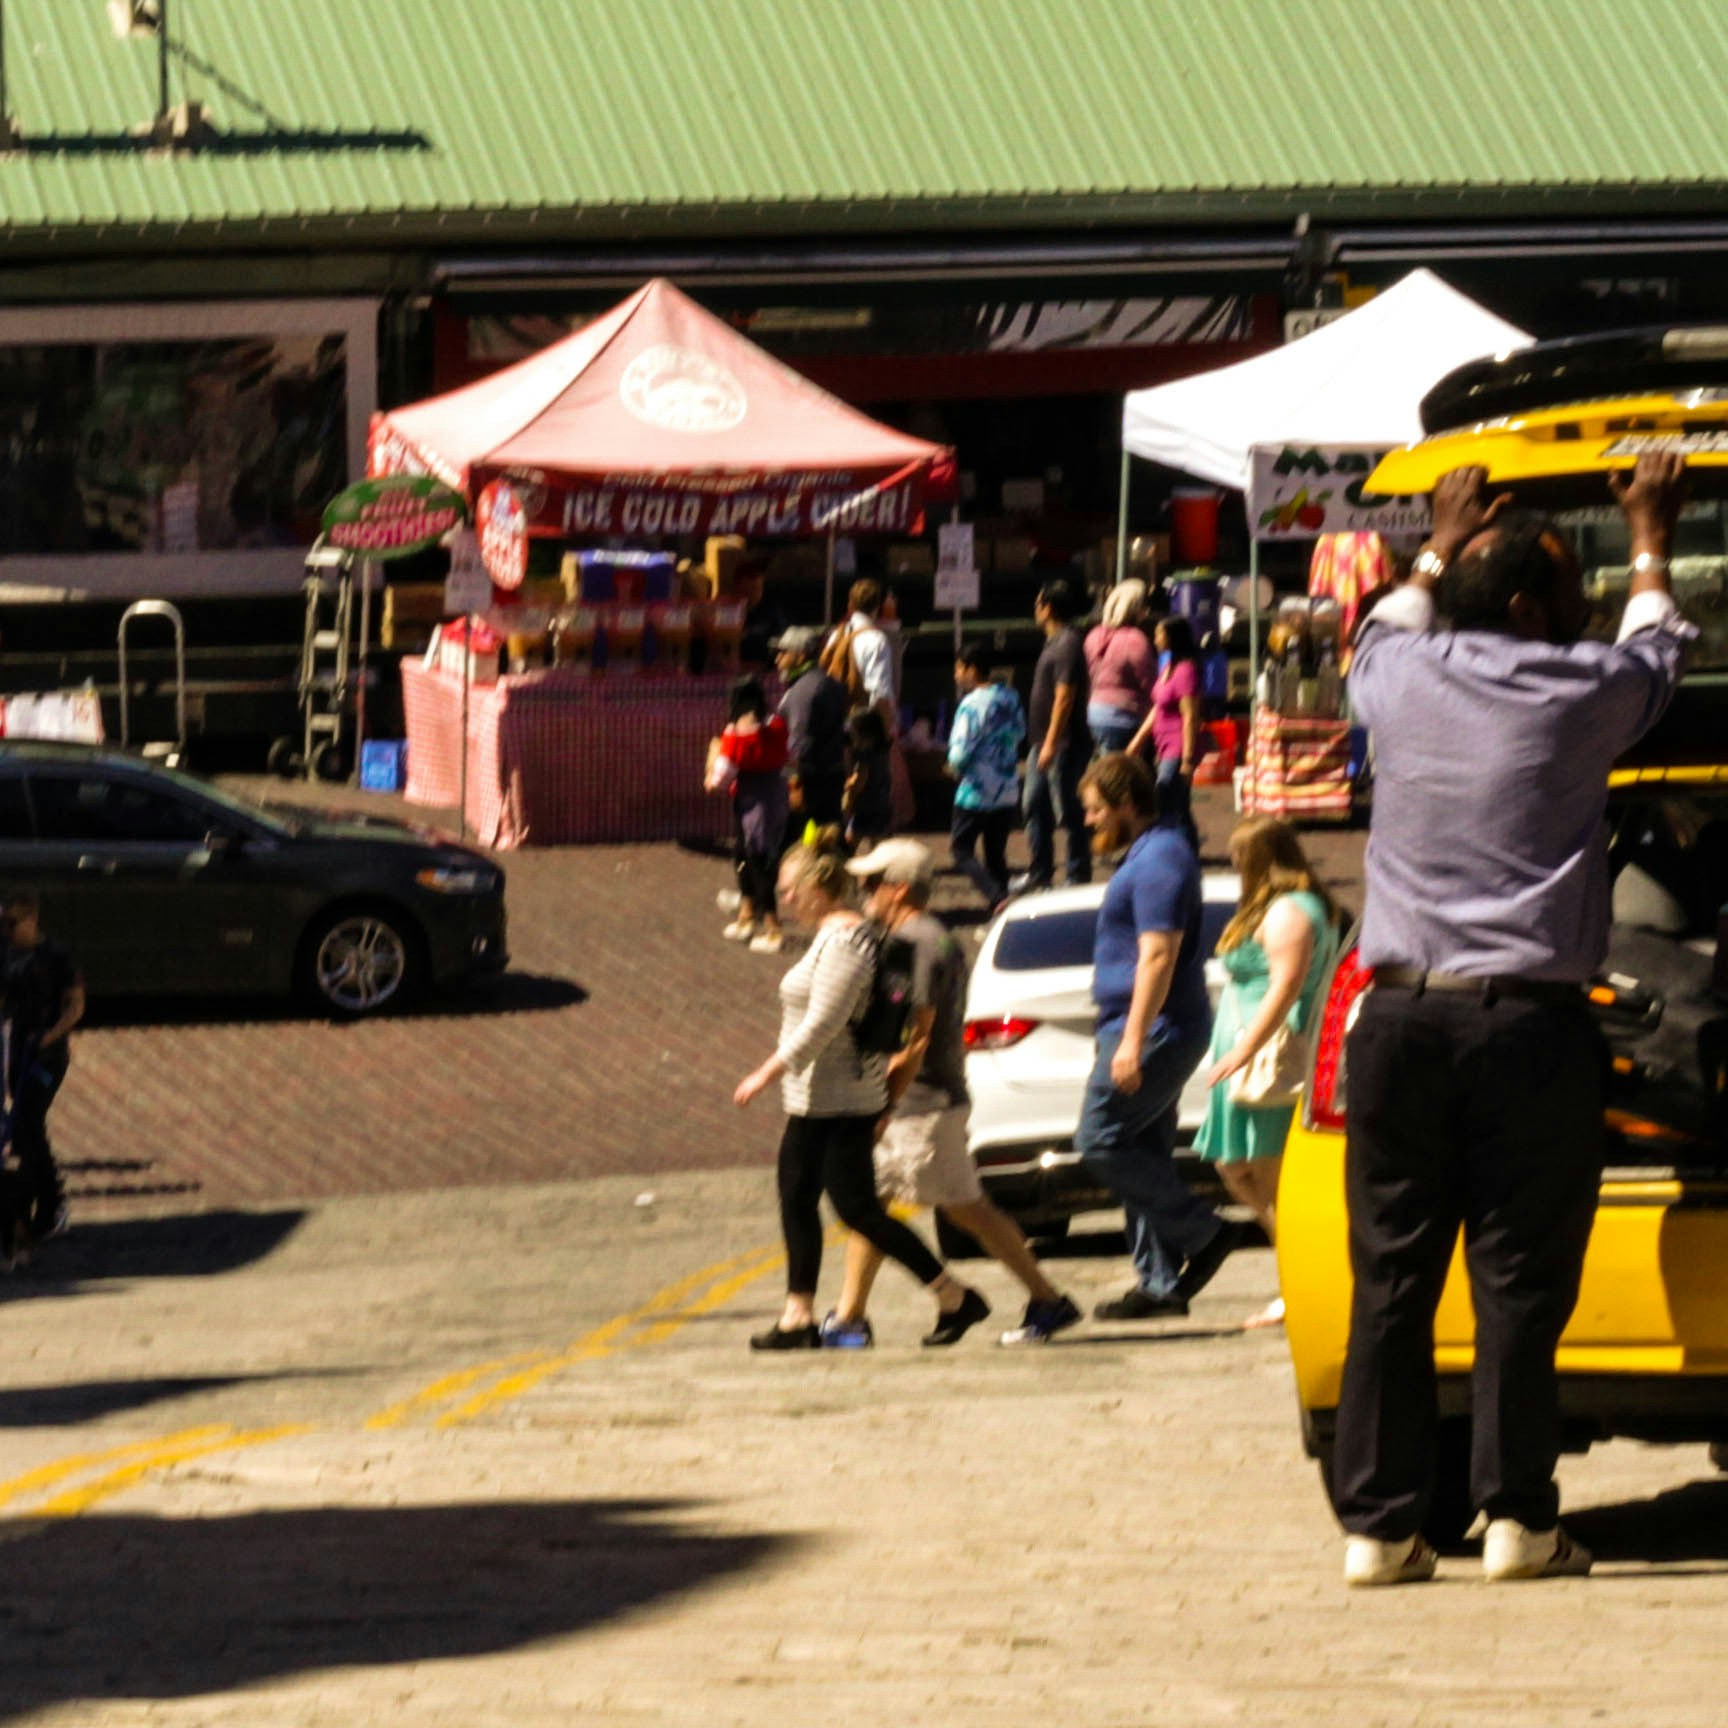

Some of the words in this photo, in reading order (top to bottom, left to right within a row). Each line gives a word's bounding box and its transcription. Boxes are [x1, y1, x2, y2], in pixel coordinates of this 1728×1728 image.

[563, 492, 614, 530] ICE
[622, 492, 699, 533] COLD
[709, 492, 802, 534] APPLE
